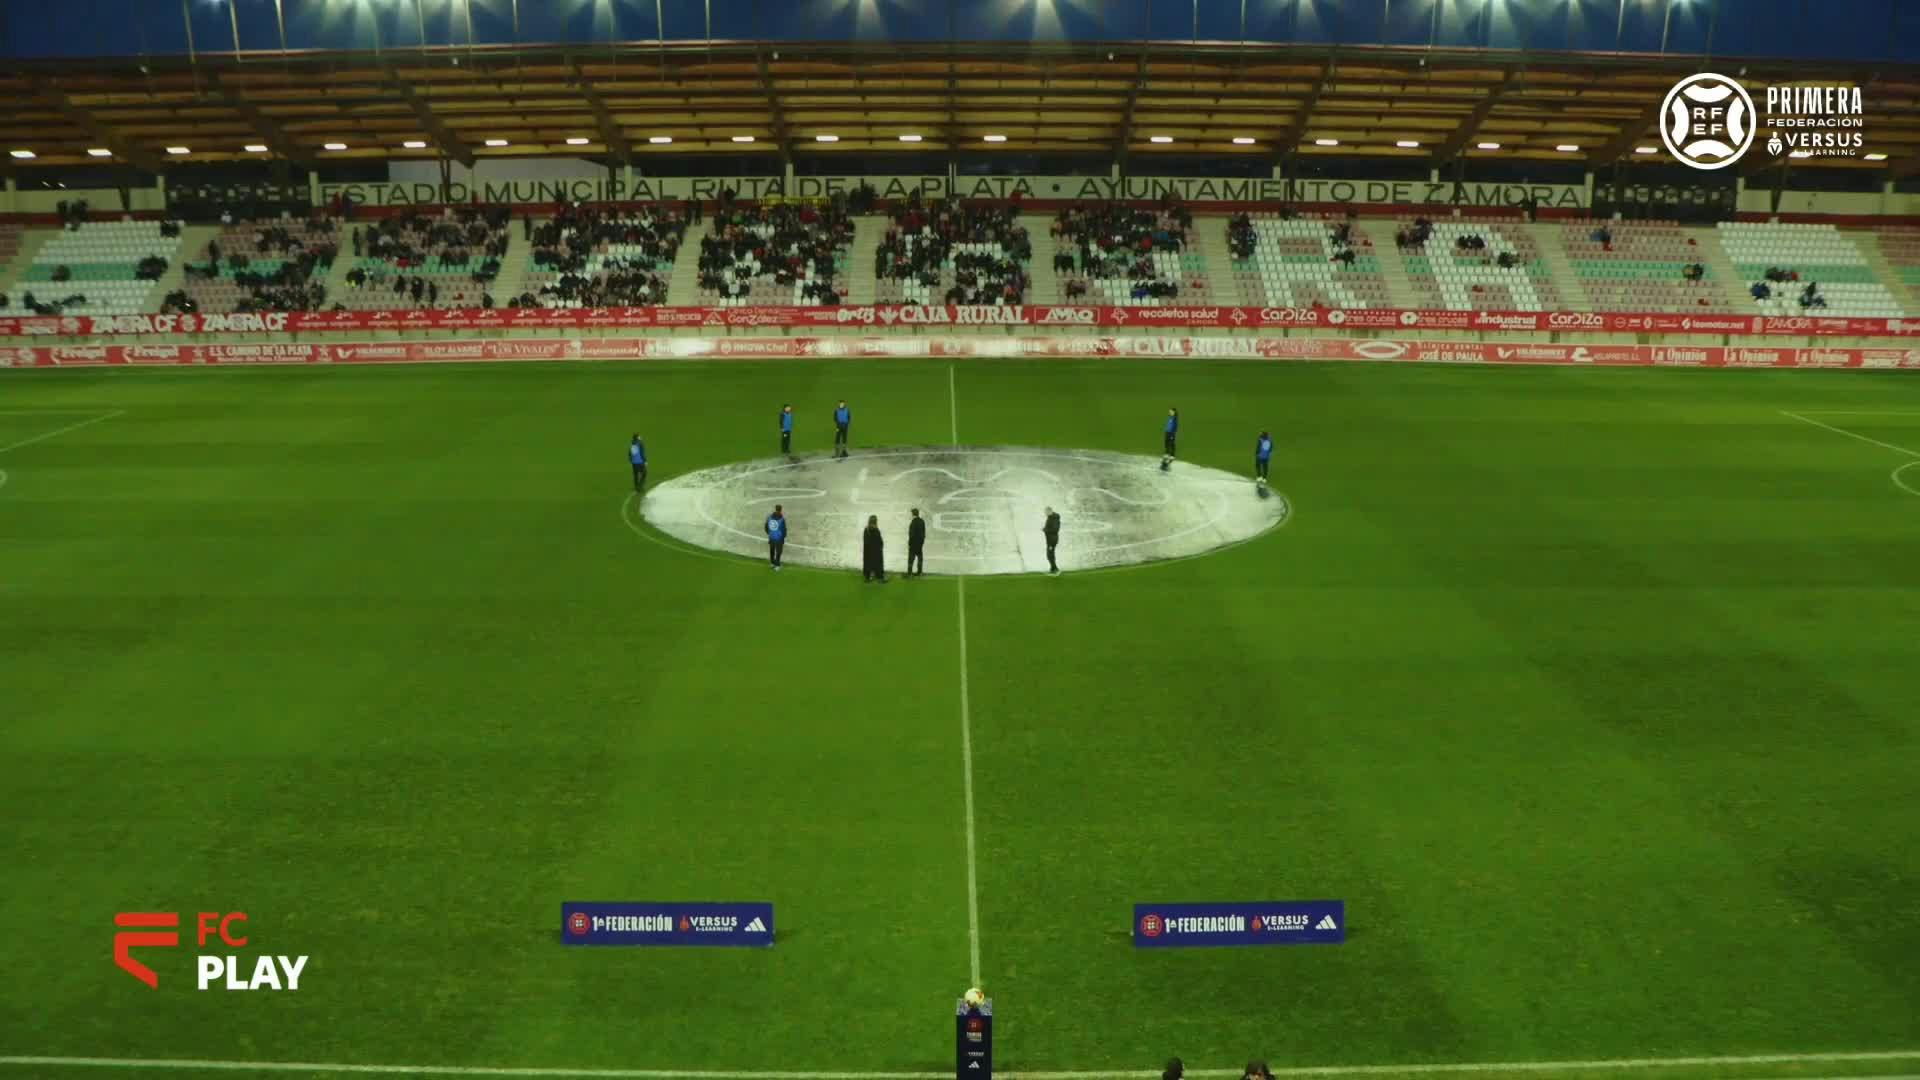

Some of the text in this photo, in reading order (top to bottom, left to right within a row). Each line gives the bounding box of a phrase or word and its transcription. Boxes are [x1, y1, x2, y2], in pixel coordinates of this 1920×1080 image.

[321, 183, 467, 206] ESTADIO
[484, 179, 678, 203] MUNICIPAL
[691, 178, 785, 200] RUTA
[920, 178, 1035, 199] PLATA
[1077, 178, 1356, 202] AYUNTAMIENTO
[1366, 182, 1412, 203] DE
[1423, 183, 1581, 208] ZAMORA
[201, 313, 288, 331] ZAMORA CF
[900, 305, 952, 324] CAJA
[1139, 308, 1219, 319] recoletas salud
[154, 315, 177, 331] CF
[690, 916, 738, 927] VERSUS
[1178, 914, 1245, 932] FEDERACIÓN
[1262, 915, 1309, 926] VERSUS
